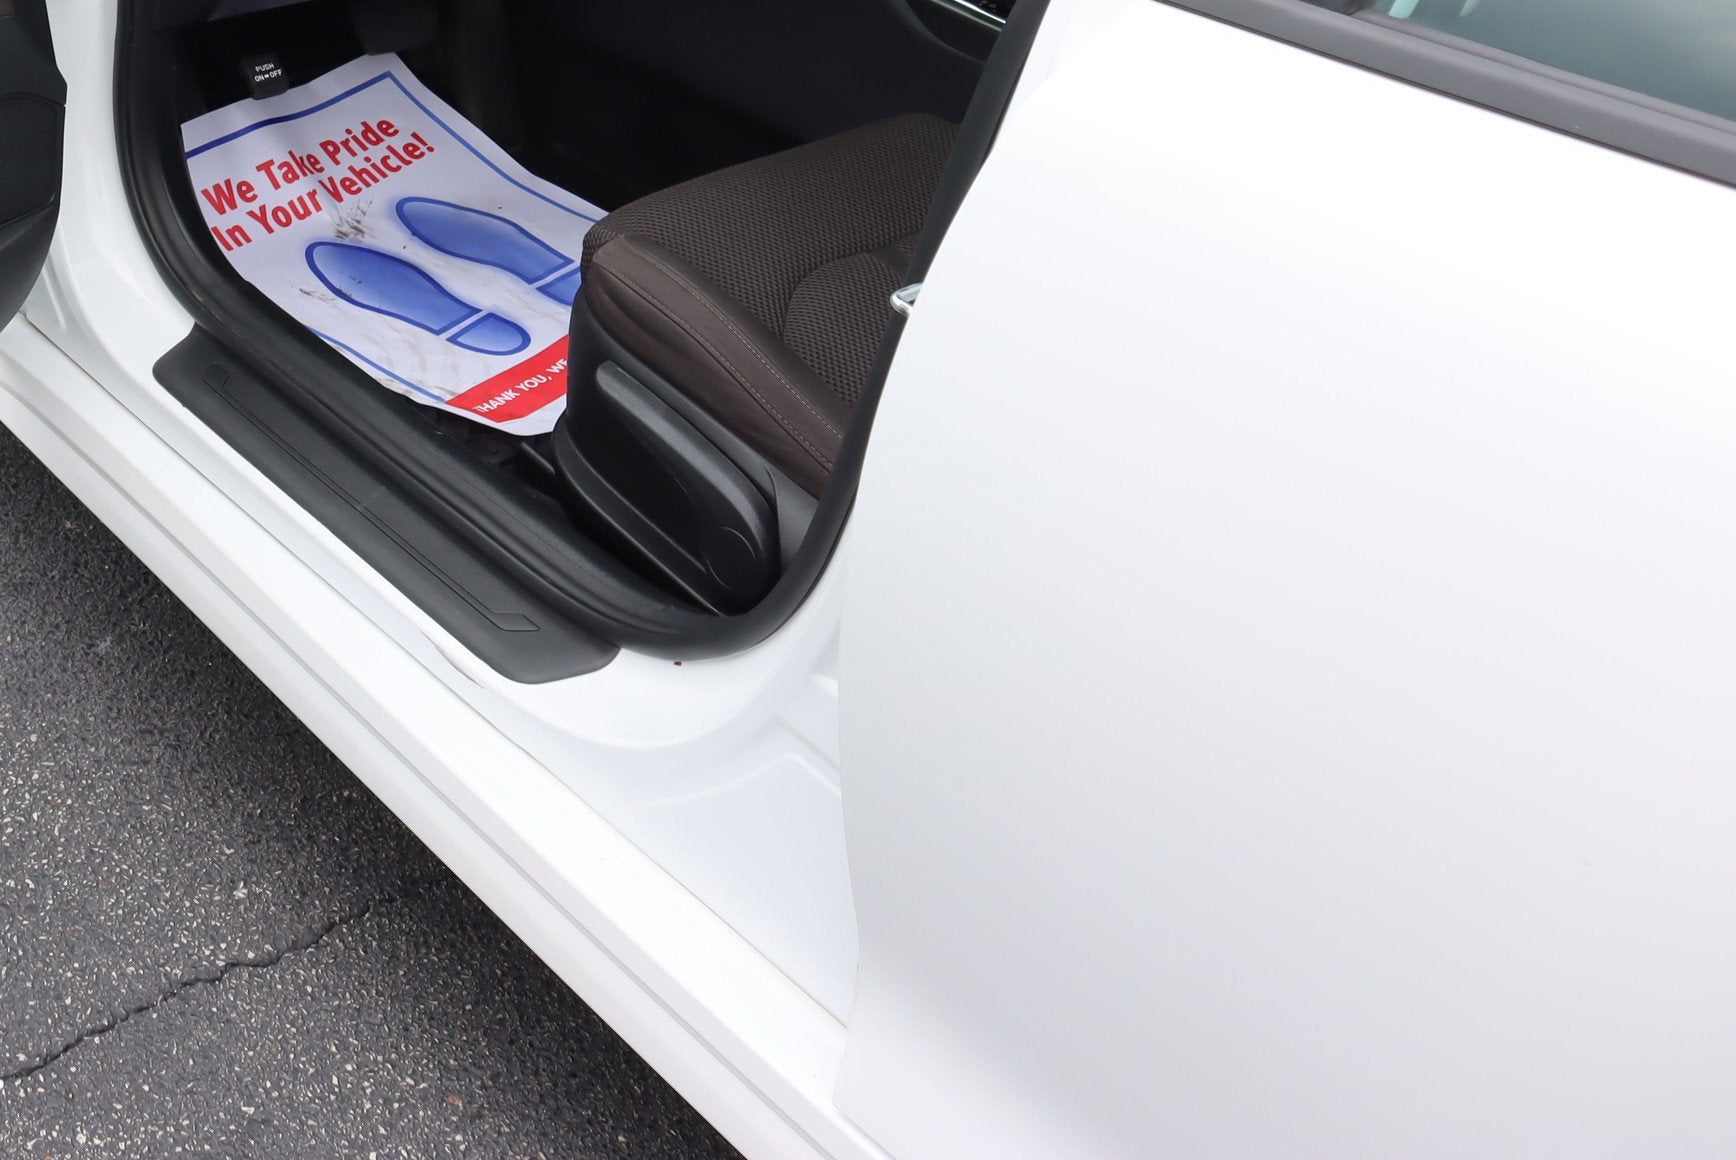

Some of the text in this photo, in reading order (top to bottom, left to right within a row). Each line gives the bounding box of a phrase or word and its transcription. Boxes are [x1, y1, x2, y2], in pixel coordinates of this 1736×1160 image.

[255, 62, 275, 73] PUSH
[201, 119, 400, 216] We Take Pride
[210, 131, 436, 252] In Your Vehicle!
[472, 388, 521, 413] THANK
[515, 374, 552, 392] YOU,
